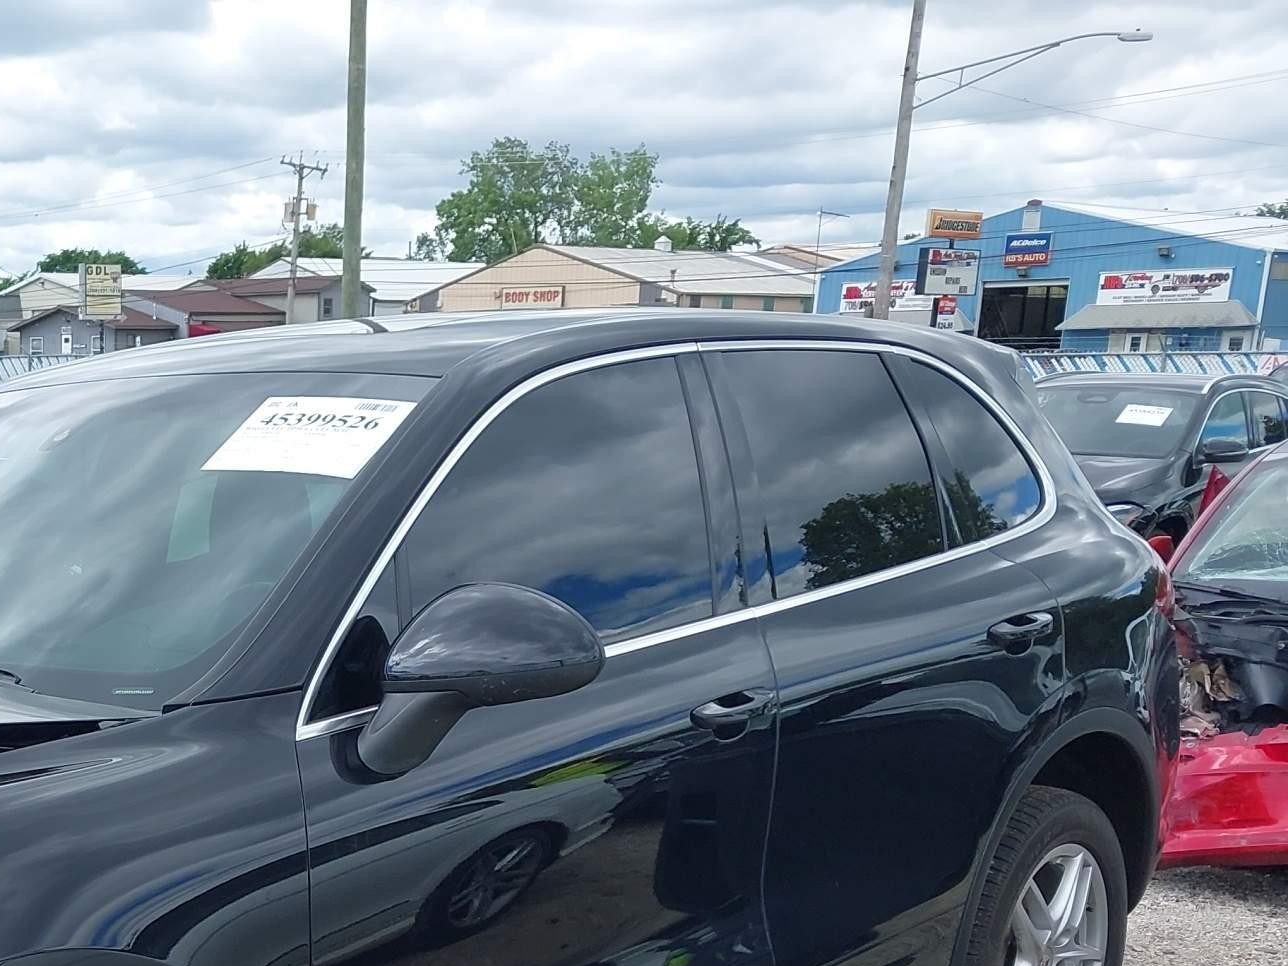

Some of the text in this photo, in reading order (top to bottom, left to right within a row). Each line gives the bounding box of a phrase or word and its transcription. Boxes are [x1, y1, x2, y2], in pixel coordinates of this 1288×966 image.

[1010, 239, 1047, 247] ACDelco
[1024, 253, 1046, 261] AUTO
[87, 265, 109, 276] GDL
[504, 290, 560, 304] BODY SHOP
[260, 412, 384, 430] 45399526
